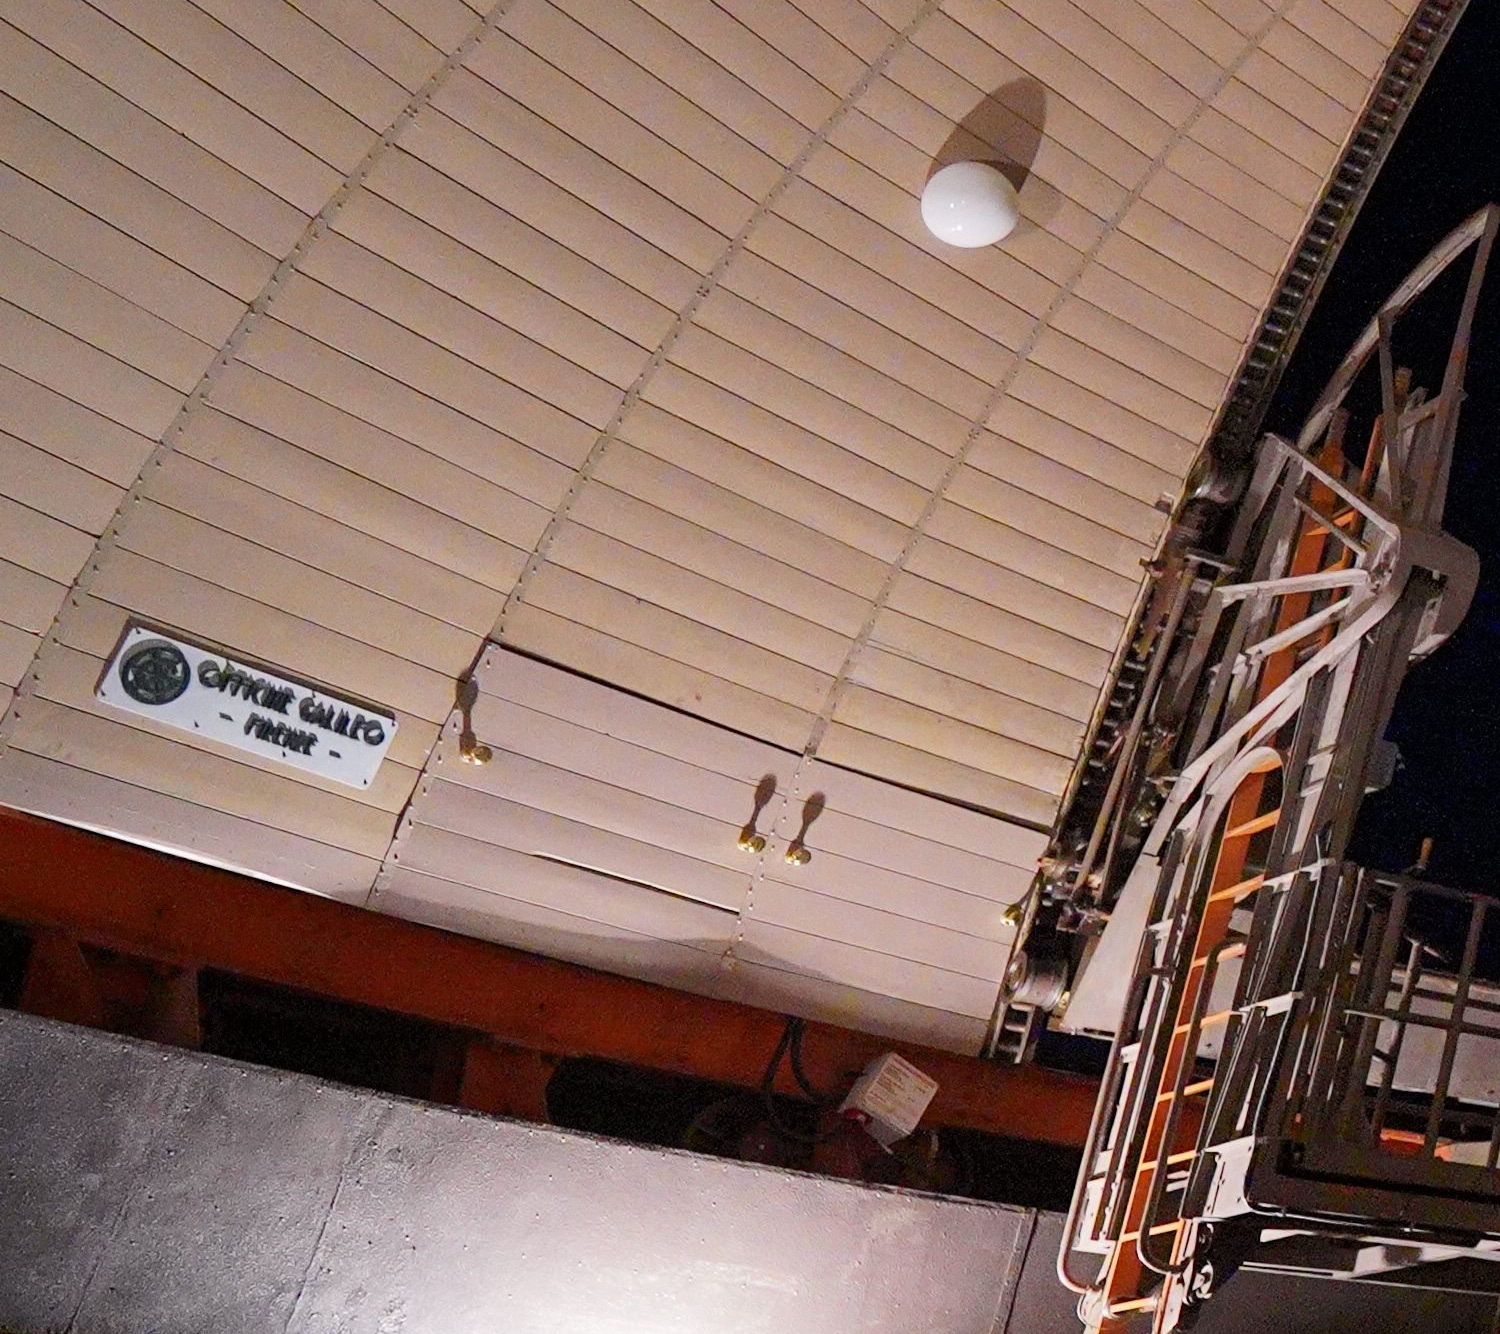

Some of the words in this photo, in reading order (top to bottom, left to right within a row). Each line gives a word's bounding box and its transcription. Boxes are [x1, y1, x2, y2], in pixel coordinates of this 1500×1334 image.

[198, 660, 297, 715] OFFICINE
[299, 696, 386, 746] GALILEO
[243, 712, 319, 757] FIRENZE
